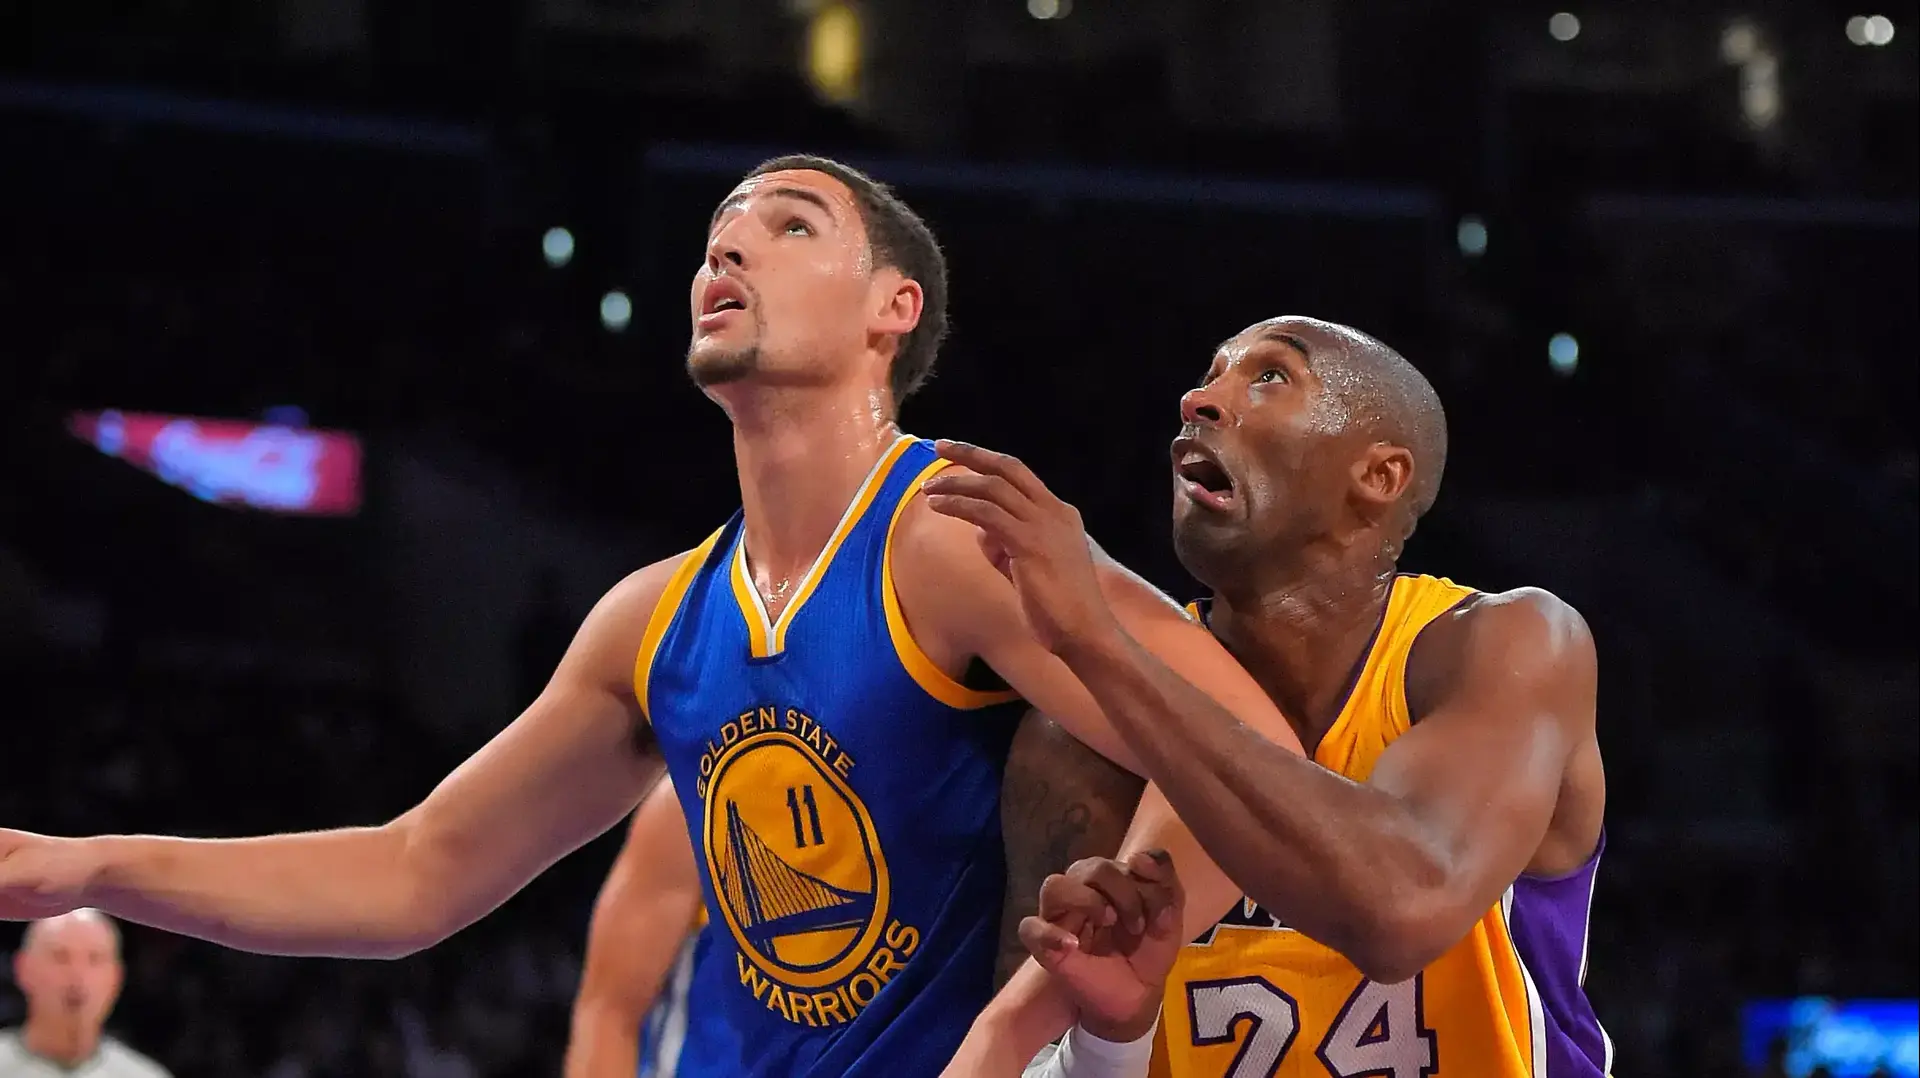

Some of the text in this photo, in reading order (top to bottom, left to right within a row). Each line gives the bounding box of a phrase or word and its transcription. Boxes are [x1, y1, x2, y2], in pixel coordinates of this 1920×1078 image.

[697, 707, 856, 799] GOLDEN STATE
[786, 784, 825, 849] 11
[736, 919, 921, 1027] WARRIORS
[1185, 970, 1439, 1078] 24
